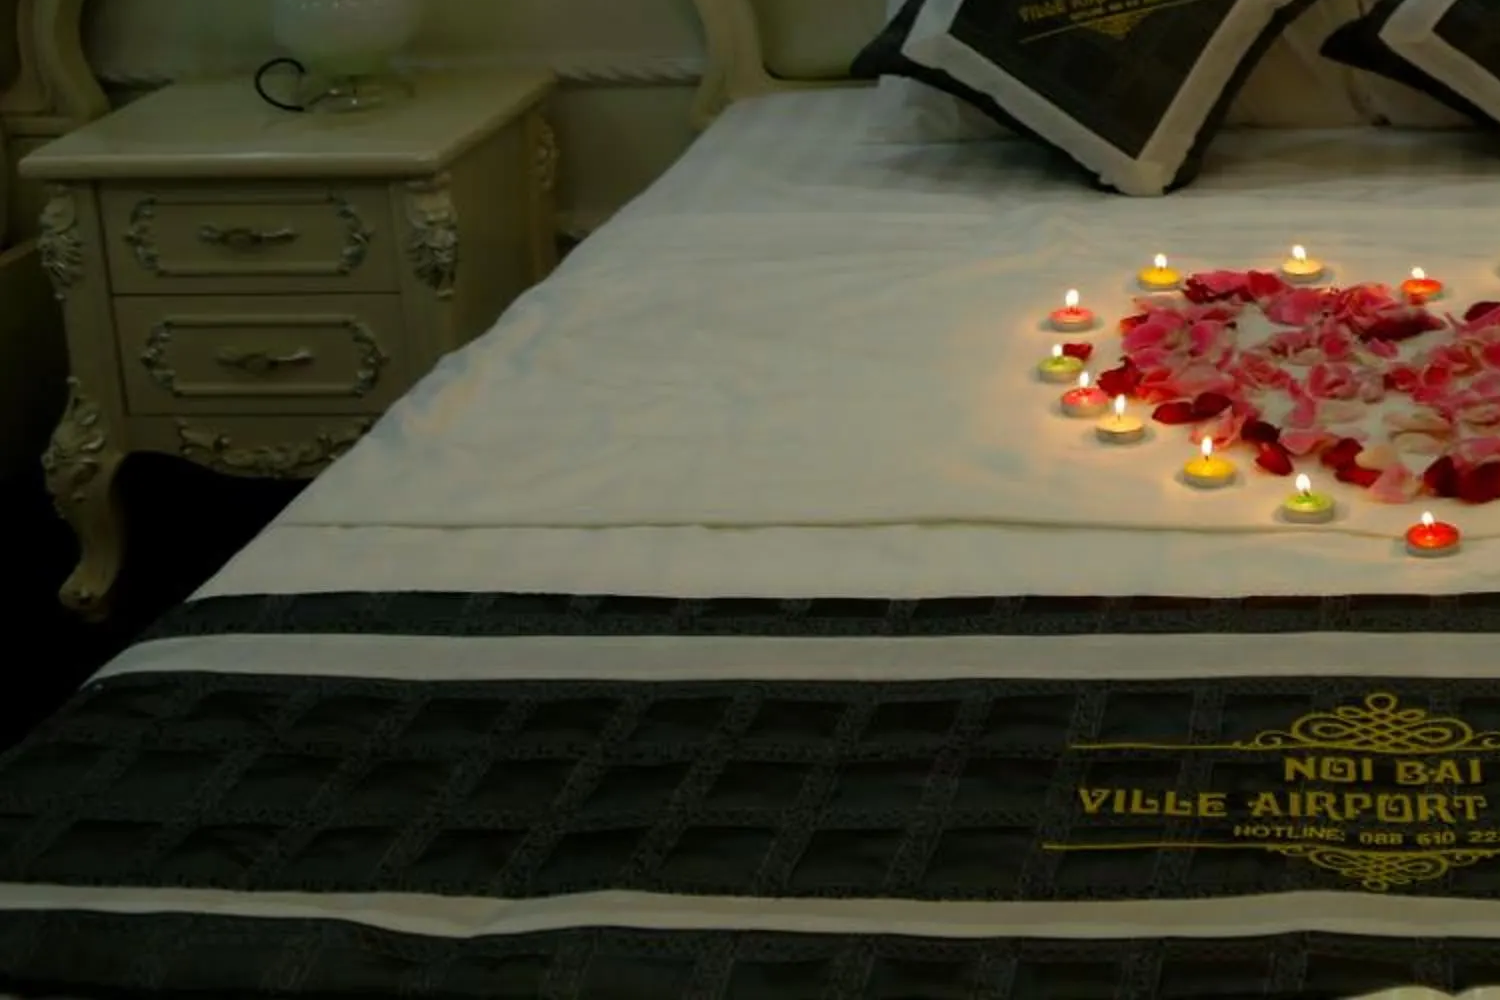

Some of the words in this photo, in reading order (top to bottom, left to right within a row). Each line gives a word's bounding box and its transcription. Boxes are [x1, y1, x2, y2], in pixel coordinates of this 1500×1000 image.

[1284, 755, 1374, 783] NOI
[1394, 758, 1484, 785] BAI
[1077, 786, 1228, 818] VILLE
[1247, 790, 1488, 823] AIRPORT
